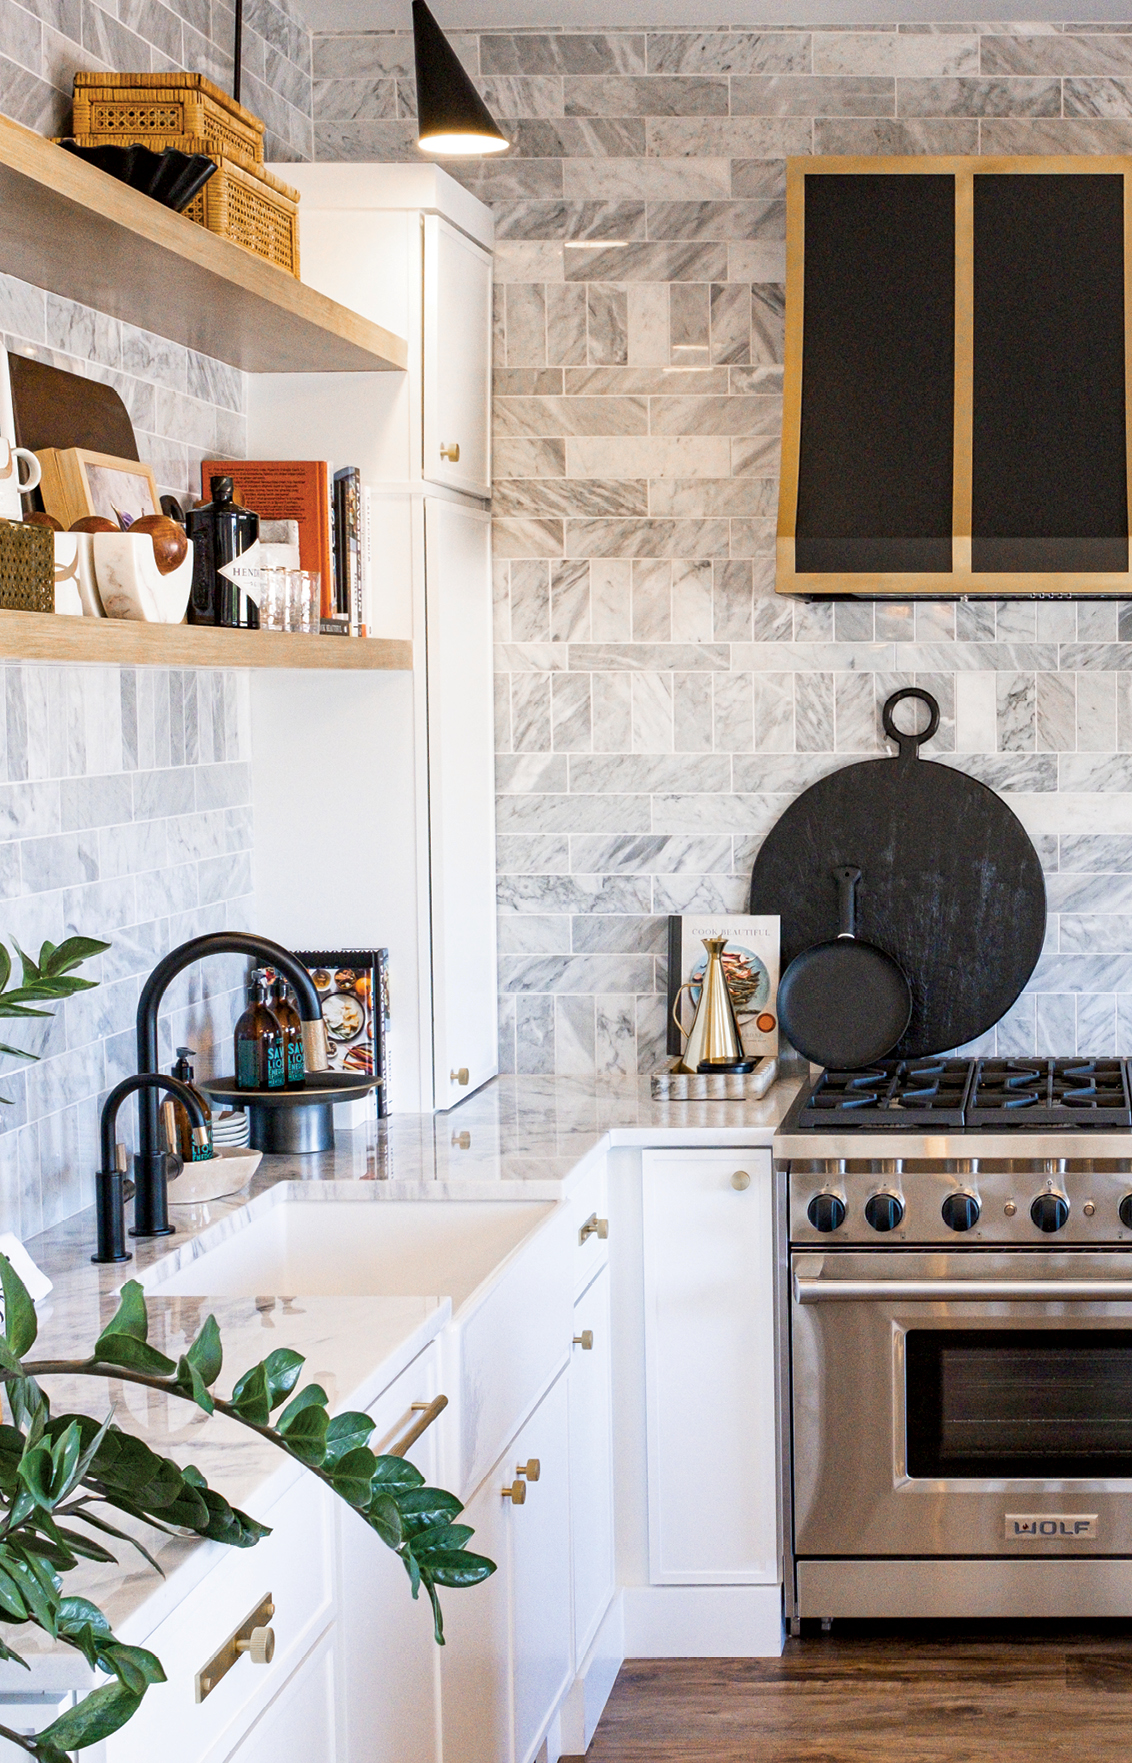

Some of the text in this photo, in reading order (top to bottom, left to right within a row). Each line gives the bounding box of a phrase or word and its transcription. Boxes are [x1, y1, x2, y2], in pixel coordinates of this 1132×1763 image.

[692, 928, 771, 937] COOK BEAUTIFUL
[1014, 1521, 1091, 1535] WOLF
